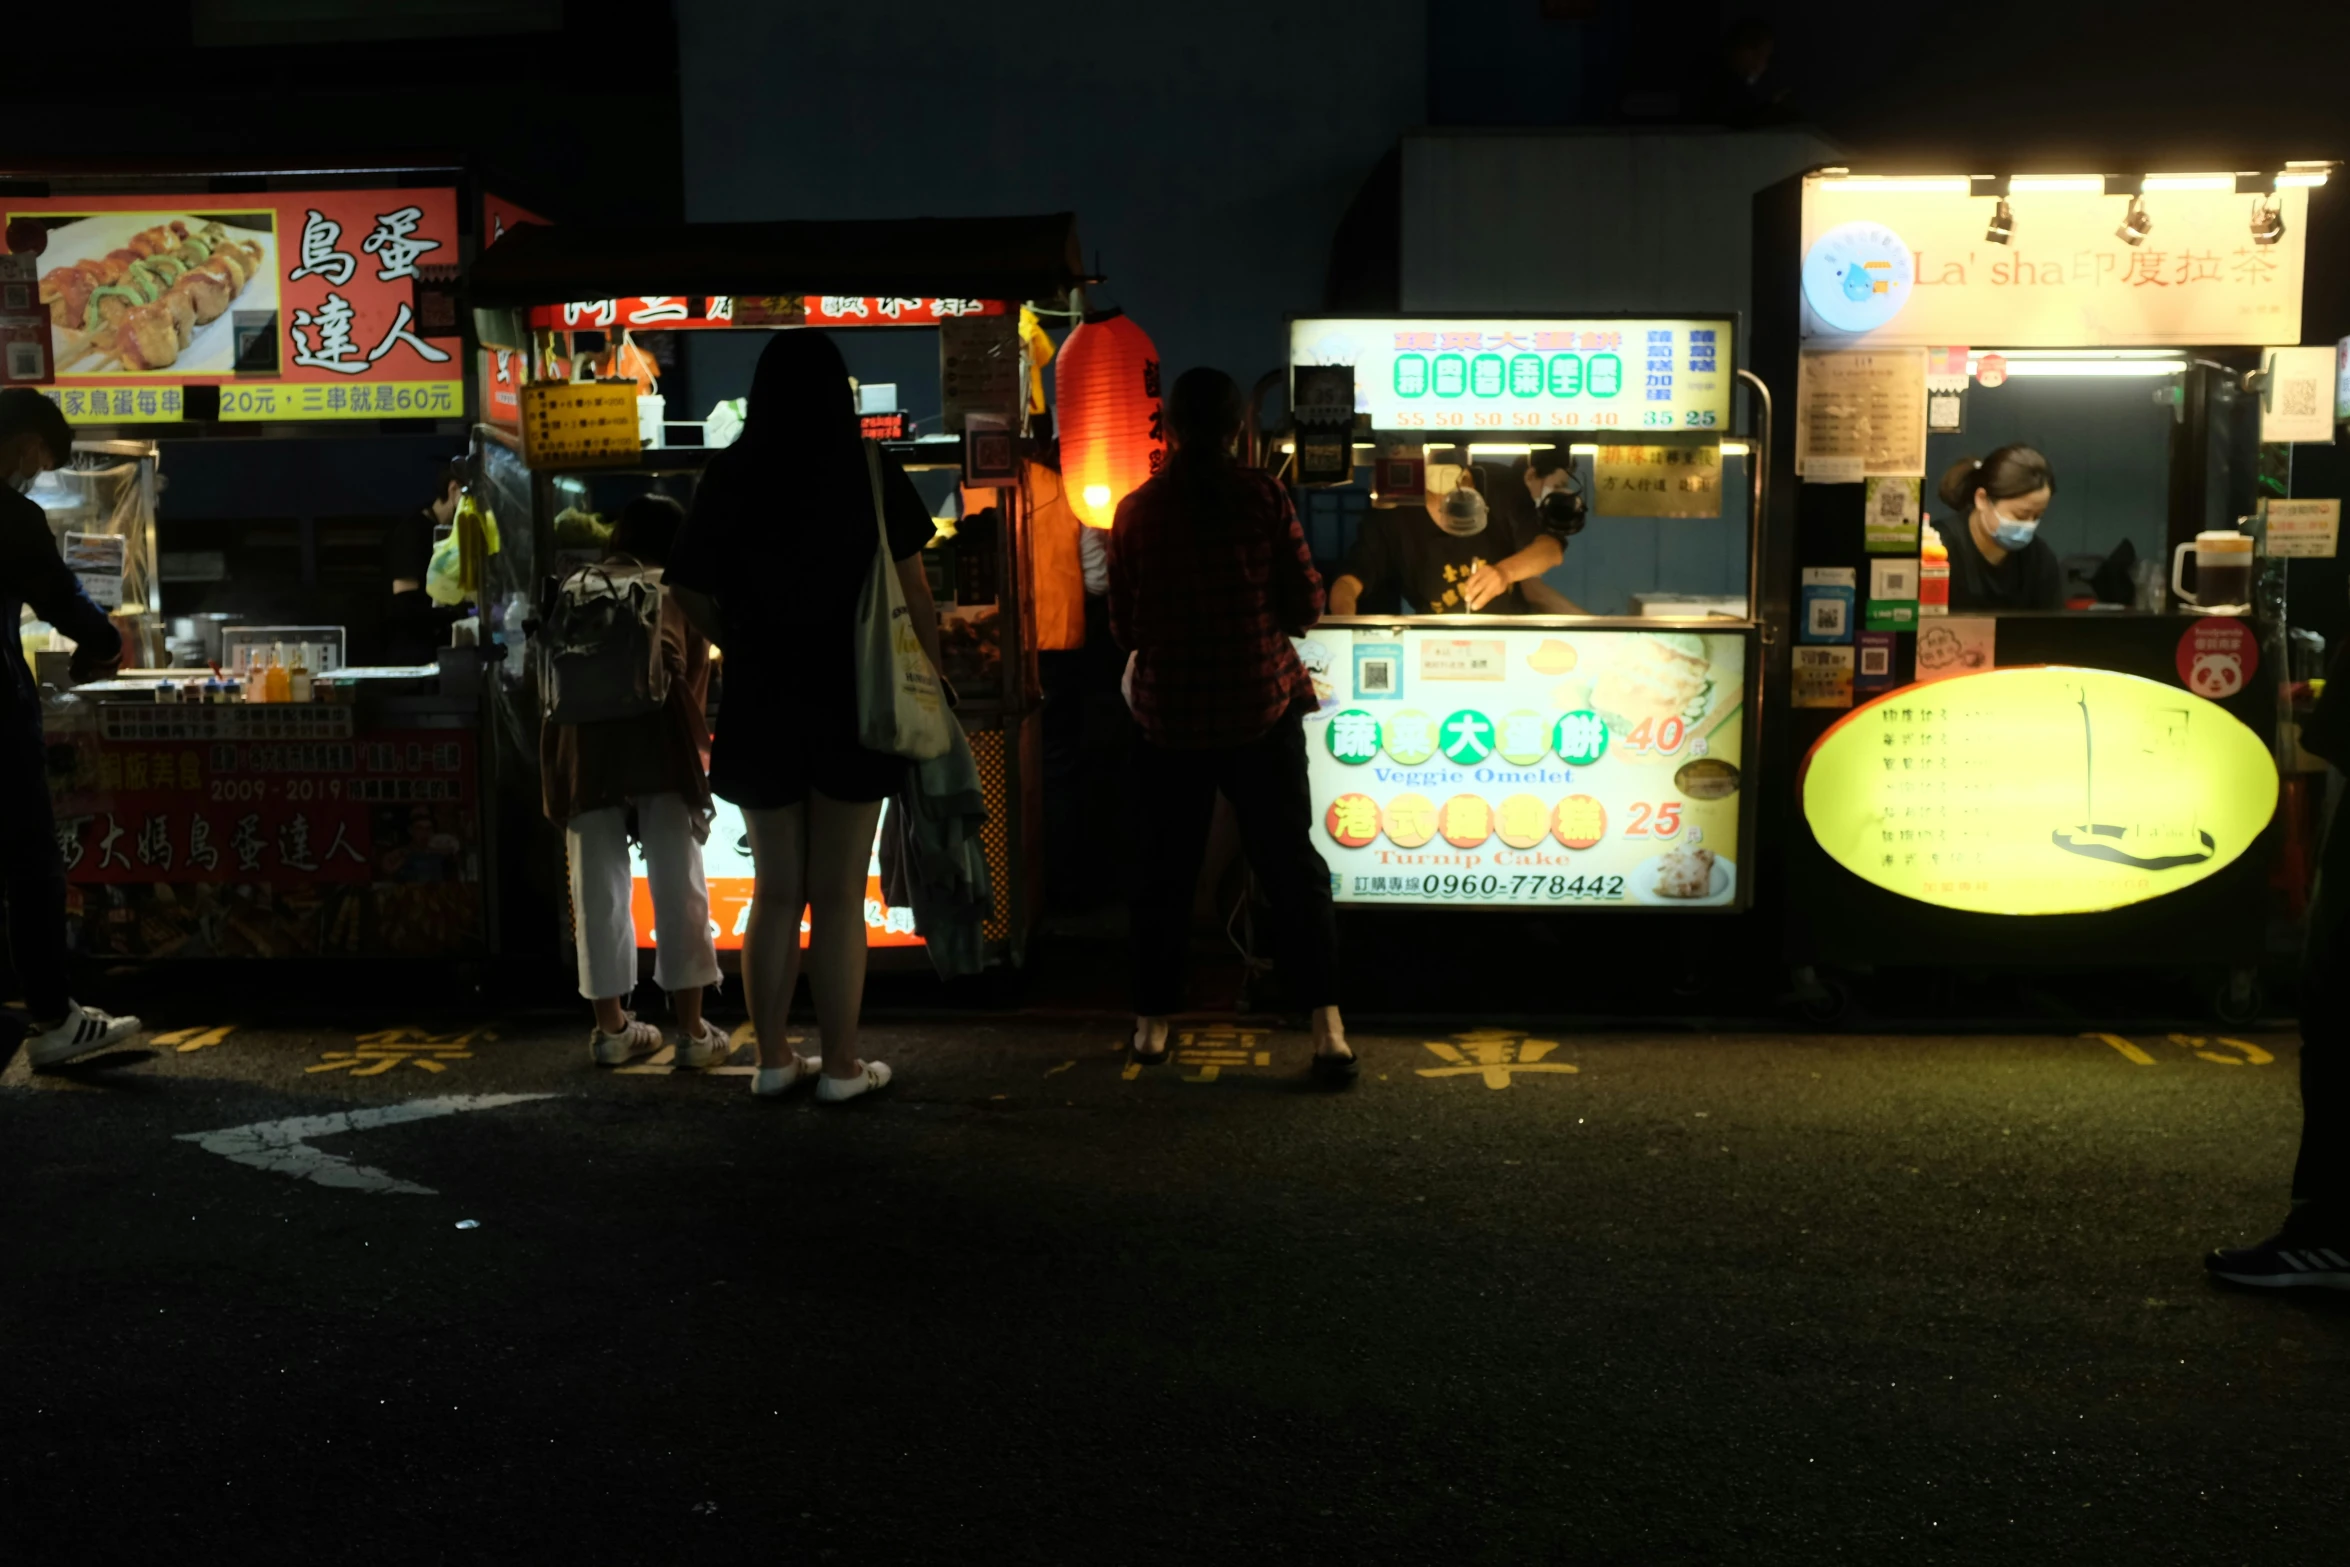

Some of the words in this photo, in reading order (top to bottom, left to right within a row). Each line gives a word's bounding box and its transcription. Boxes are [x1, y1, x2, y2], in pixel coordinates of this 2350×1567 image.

[288, 206, 441, 288] 鳥蛋
[2072, 246, 2278, 288] 印度拉茶
[288, 294, 452, 375] 達人
[1514, 359, 1539, 393] 玉米
[1398, 411, 1424, 427] 55
[1435, 411, 1464, 427] 50
[1474, 411, 1502, 427] 50
[1512, 411, 1540, 427] 50
[1551, 411, 1580, 427] 50
[1590, 411, 1618, 427] 40
[1644, 411, 1673, 427] 35
[1686, 410, 1716, 427] 25
[1331, 713, 1606, 760] 蔬菜大蛋餅
[1624, 716, 1687, 756] 40
[1374, 767, 1464, 788] Veggie
[1474, 767, 1575, 785] Omelet
[1334, 796, 1604, 842] 港式蘿蔔糕
[1622, 802, 1684, 840] 25
[1378, 850, 1482, 869] Turnip
[1492, 850, 1571, 867] Cake
[1353, 875, 1421, 894] 訂購專線
[1422, 873, 1626, 898] 0960-778442
